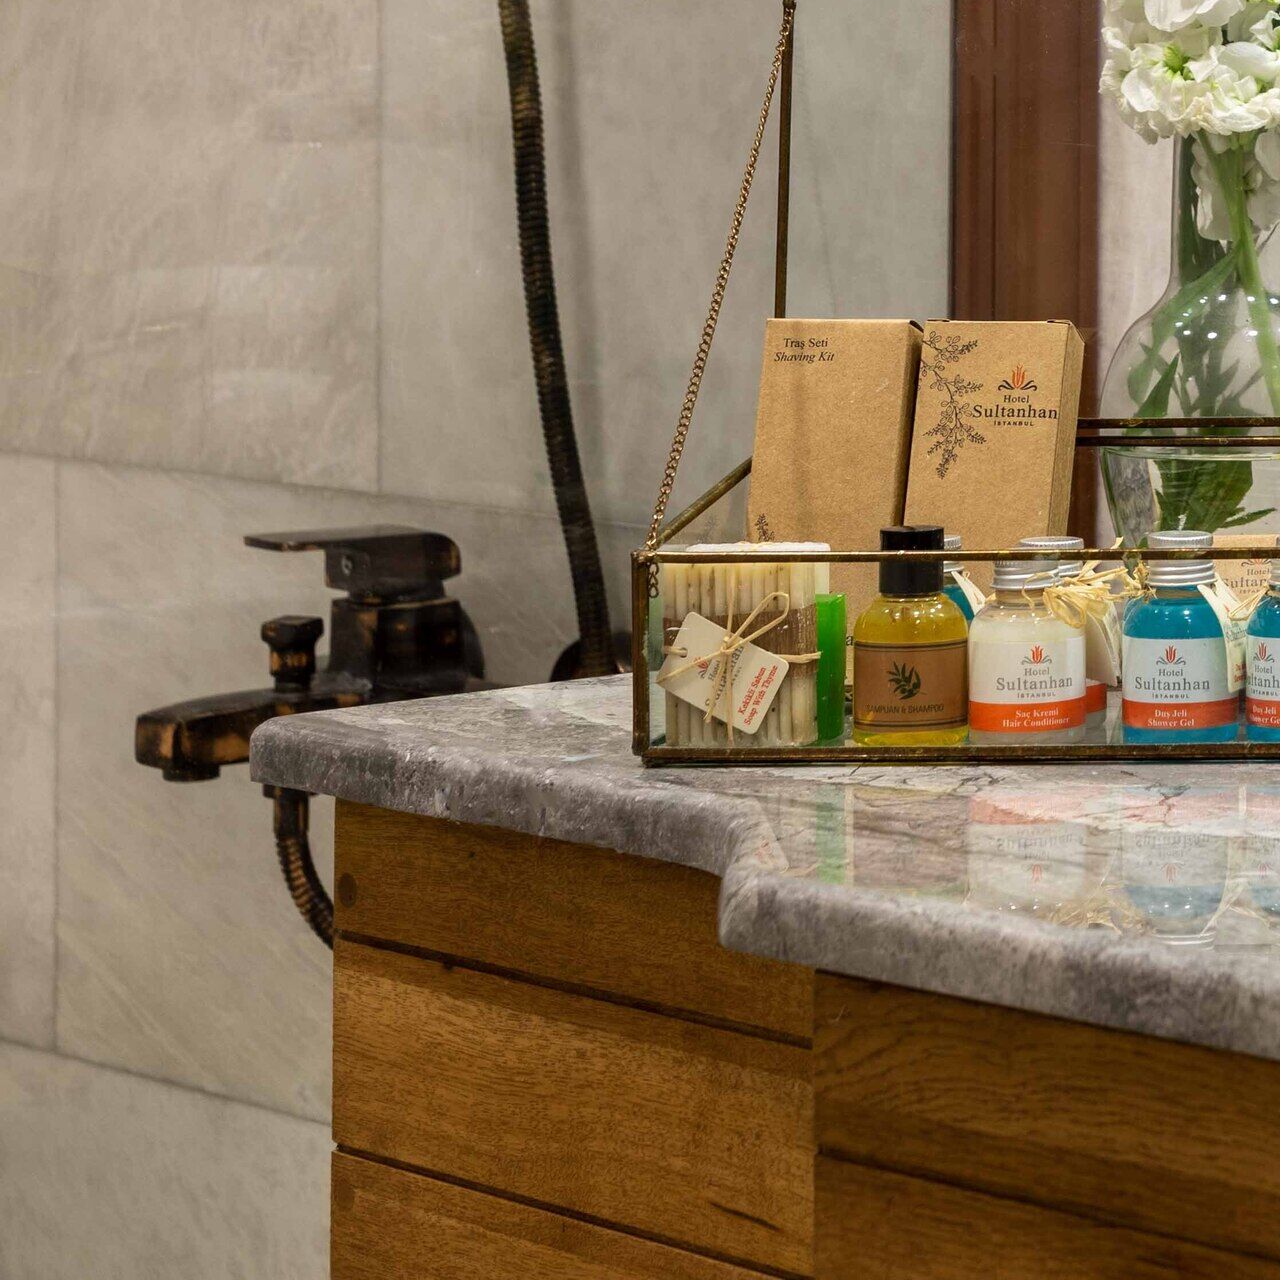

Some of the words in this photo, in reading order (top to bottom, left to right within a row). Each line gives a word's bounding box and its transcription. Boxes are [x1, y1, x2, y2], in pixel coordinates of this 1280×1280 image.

[783, 337, 805, 350] Traş
[808, 337, 828, 347] Seti
[774, 351, 816, 364] Shaving
[818, 351, 835, 361] Kit
[1003, 395, 1029, 403] Hotel
[972, 404, 1058, 419] Sultanhan
[1246, 568, 1270, 576] Hotel
[1024, 667, 1049, 676] Hotel
[1158, 668, 1183, 677] Hotel
[1254, 665, 1273, 674] Hotel
[996, 676, 1073, 691] Sultanhan
[1135, 677, 1210, 691] Sultanhan
[1002, 719, 1021, 728] Hair
[1023, 717, 1070, 727] Conditioner
[1147, 719, 1177, 727] Shower
[1179, 719, 1195, 727] Gel
